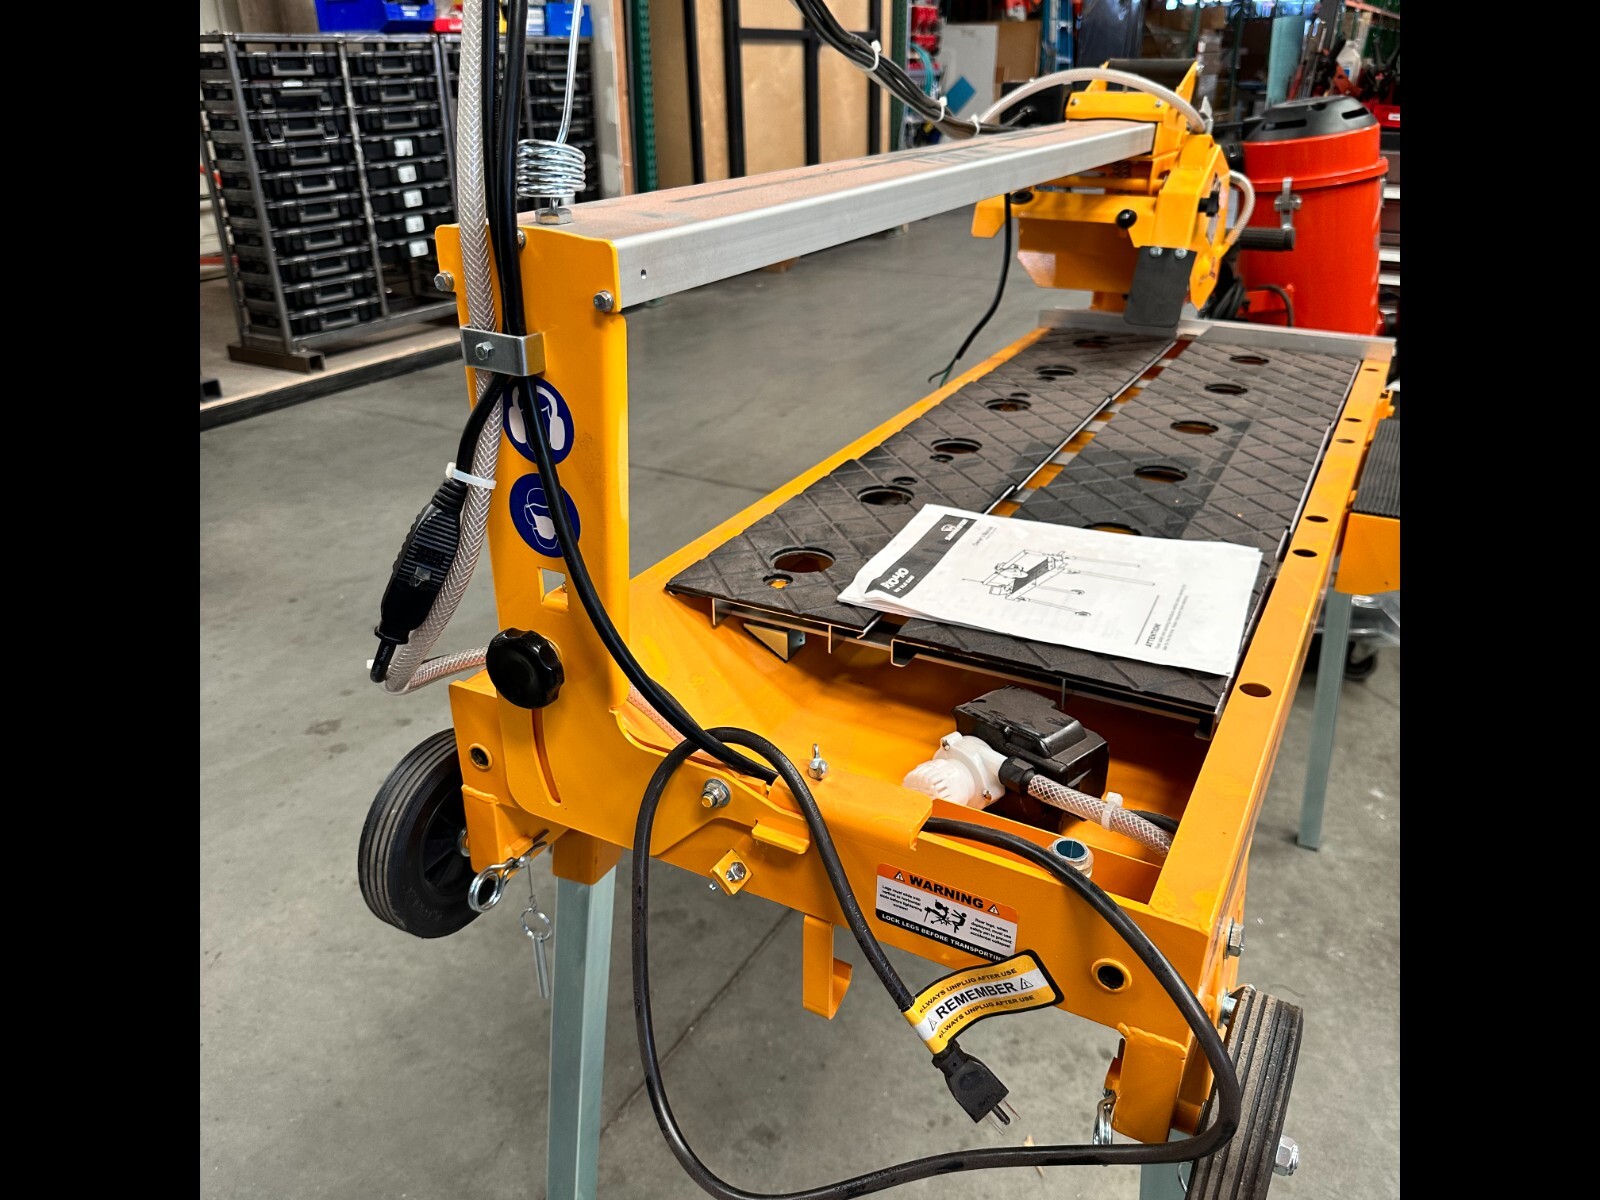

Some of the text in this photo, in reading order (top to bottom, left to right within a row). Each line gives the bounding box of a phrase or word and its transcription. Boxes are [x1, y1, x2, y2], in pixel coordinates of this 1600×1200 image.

[909, 874, 984, 909] WARNING
[881, 913, 1005, 961] LOCK LEGS BEFORE TRANSPORTIN
[946, 977, 977, 992] UNPLUG
[977, 973, 1001, 981] AFTER
[1000, 968, 1018, 977] USE
[935, 982, 1018, 1020] REMEMBER
[964, 1001, 995, 1016] UNPLUG
[995, 998, 1018, 1006] AFTER
[1019, 994, 1035, 1003] USE
